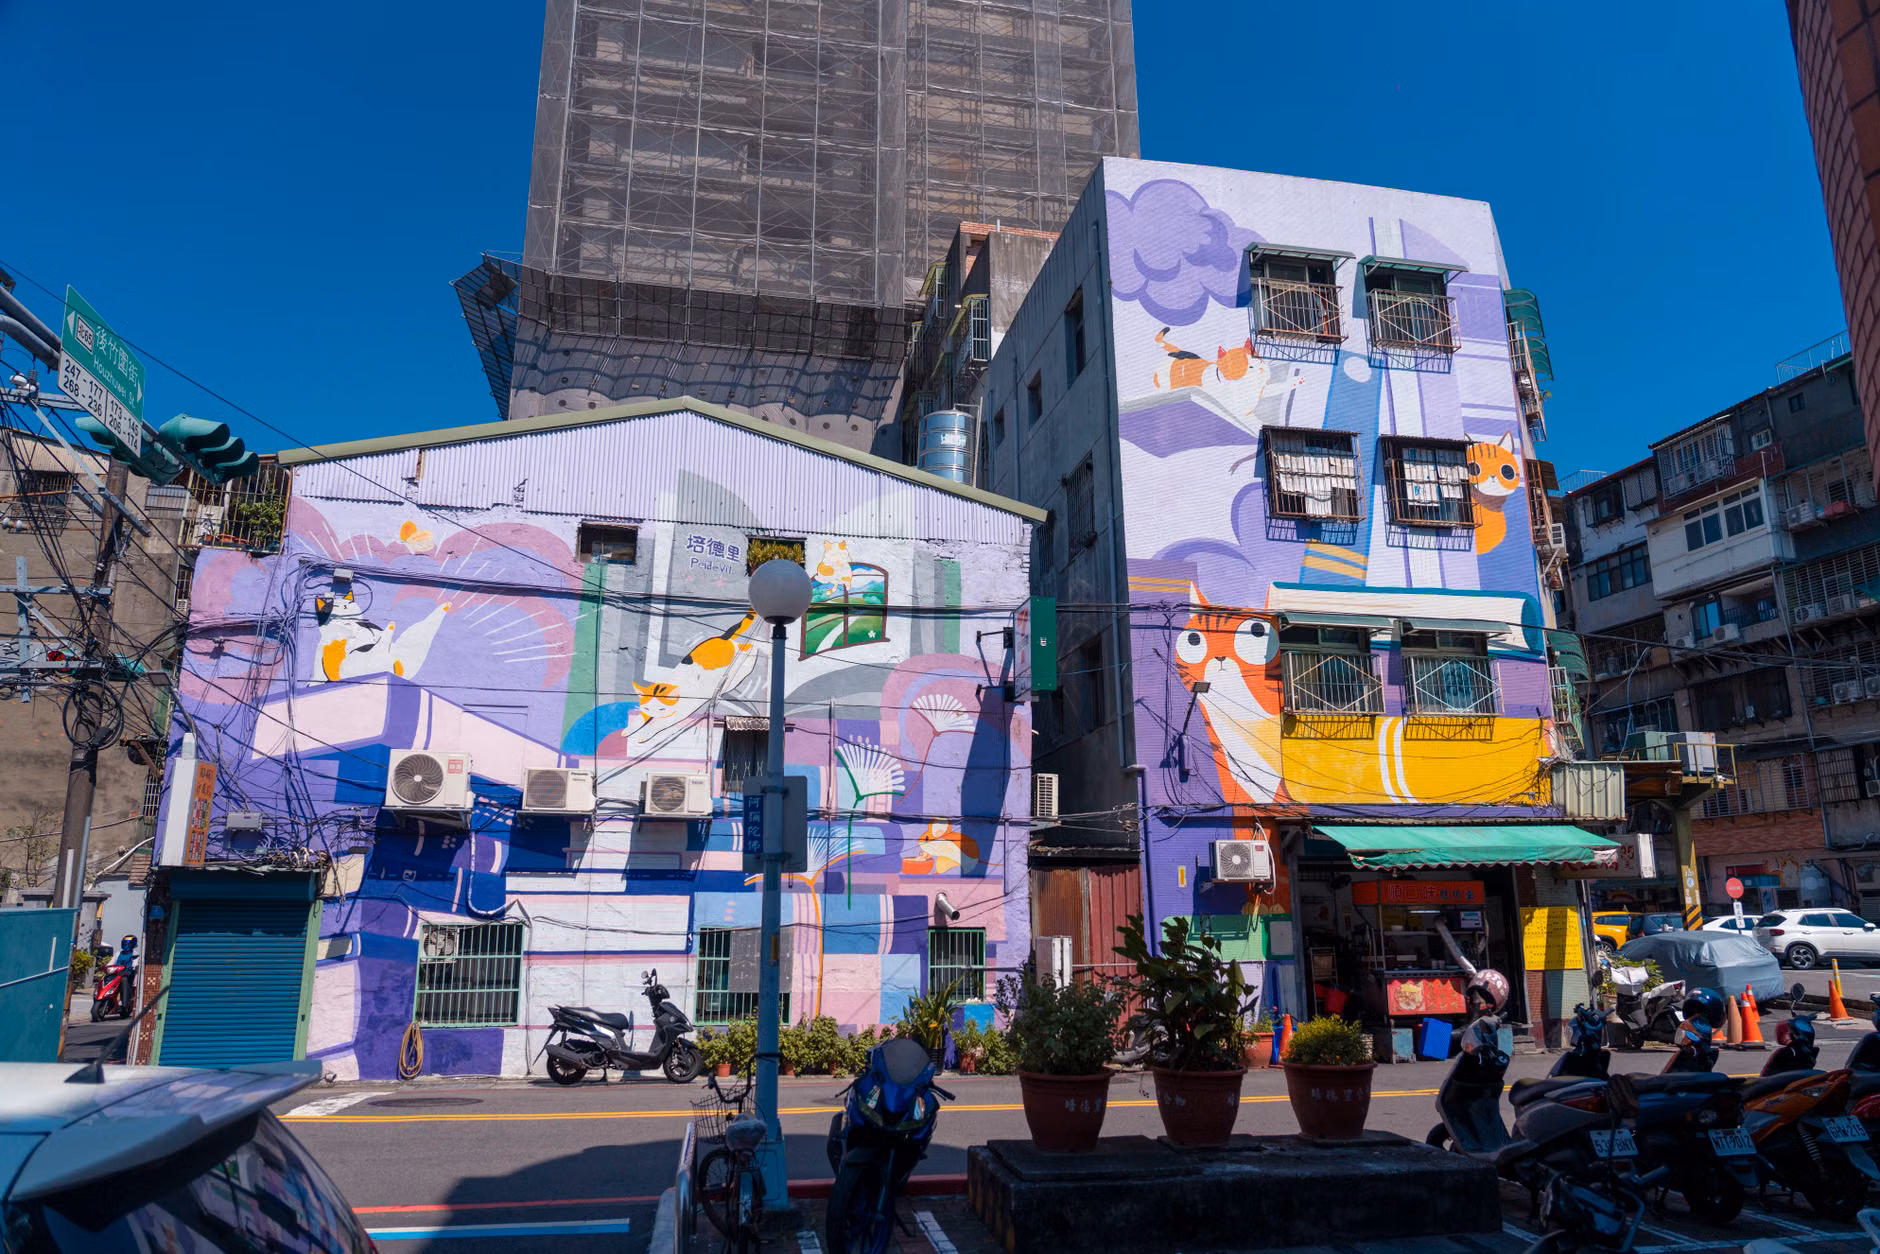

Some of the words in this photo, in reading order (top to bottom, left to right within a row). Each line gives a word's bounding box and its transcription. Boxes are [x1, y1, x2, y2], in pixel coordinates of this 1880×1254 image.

[96, 325, 138, 386] 後竹圍街
[63, 375, 80, 397] 268
[88, 396, 102, 417] 236
[64, 359, 81, 381] 247
[89, 380, 104, 400] 177
[110, 400, 122, 418] 173
[128, 420, 139, 436] 145
[127, 432, 138, 450] 174
[686, 533, 740, 562] 培德里
[748, 797, 761, 853] 阿彌陀佛
